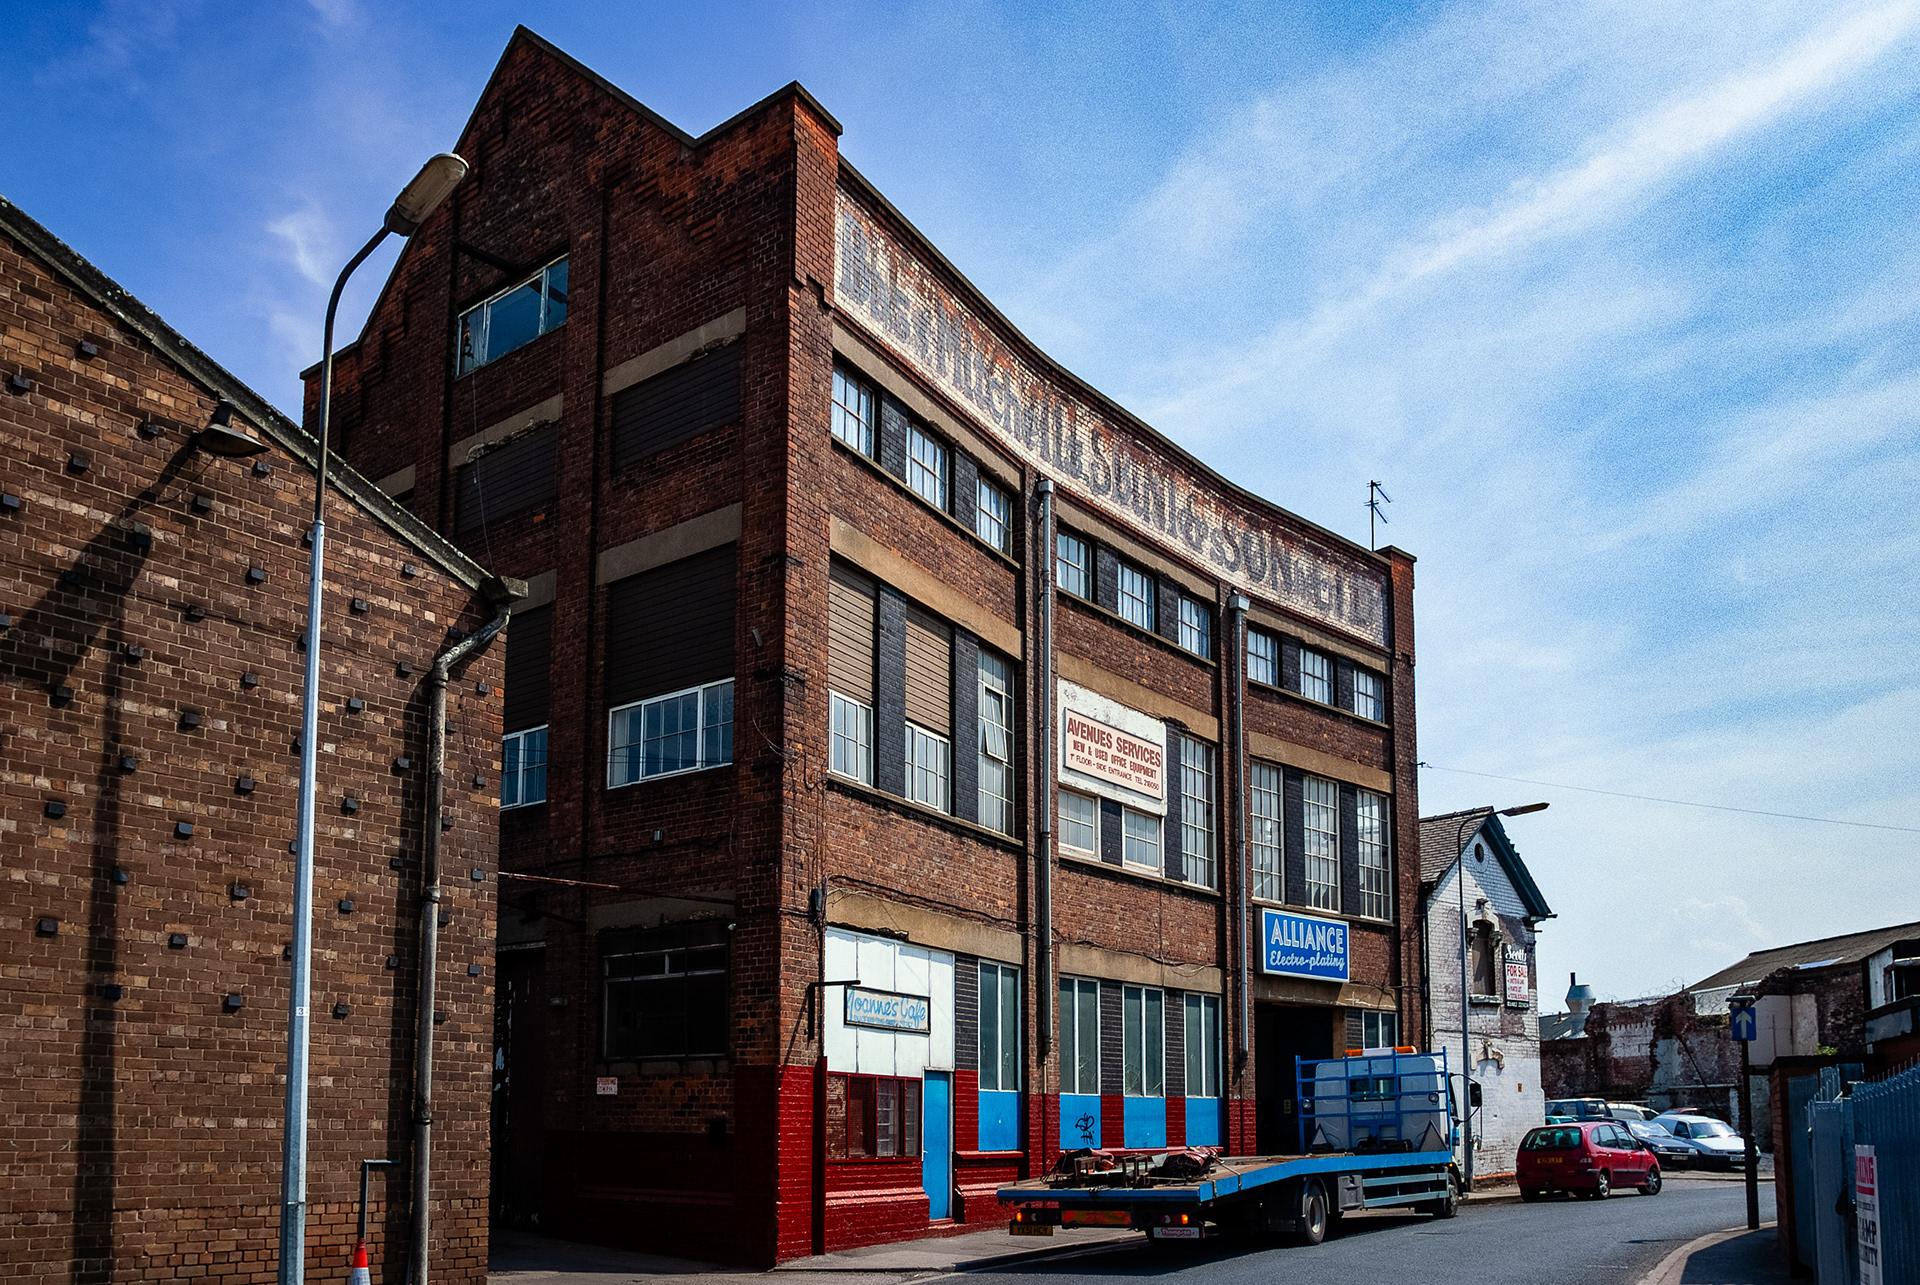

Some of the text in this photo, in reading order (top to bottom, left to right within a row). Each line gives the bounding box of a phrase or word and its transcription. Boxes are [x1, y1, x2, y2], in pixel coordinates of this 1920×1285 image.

[1067, 717, 1161, 768] AVENUES SERVICES
[1073, 740, 1157, 779] NEW & USED OFFICE EQUIPMENT
[1076, 755, 1092, 767] FLOOR
[1096, 762, 1107, 772] SIDE
[1108, 766, 1132, 782] ENTRANCE
[1270, 917, 1344, 954] ALLIANCE
[1269, 950, 1345, 971] Electro-plating
[1507, 964, 1517, 977] FOR
